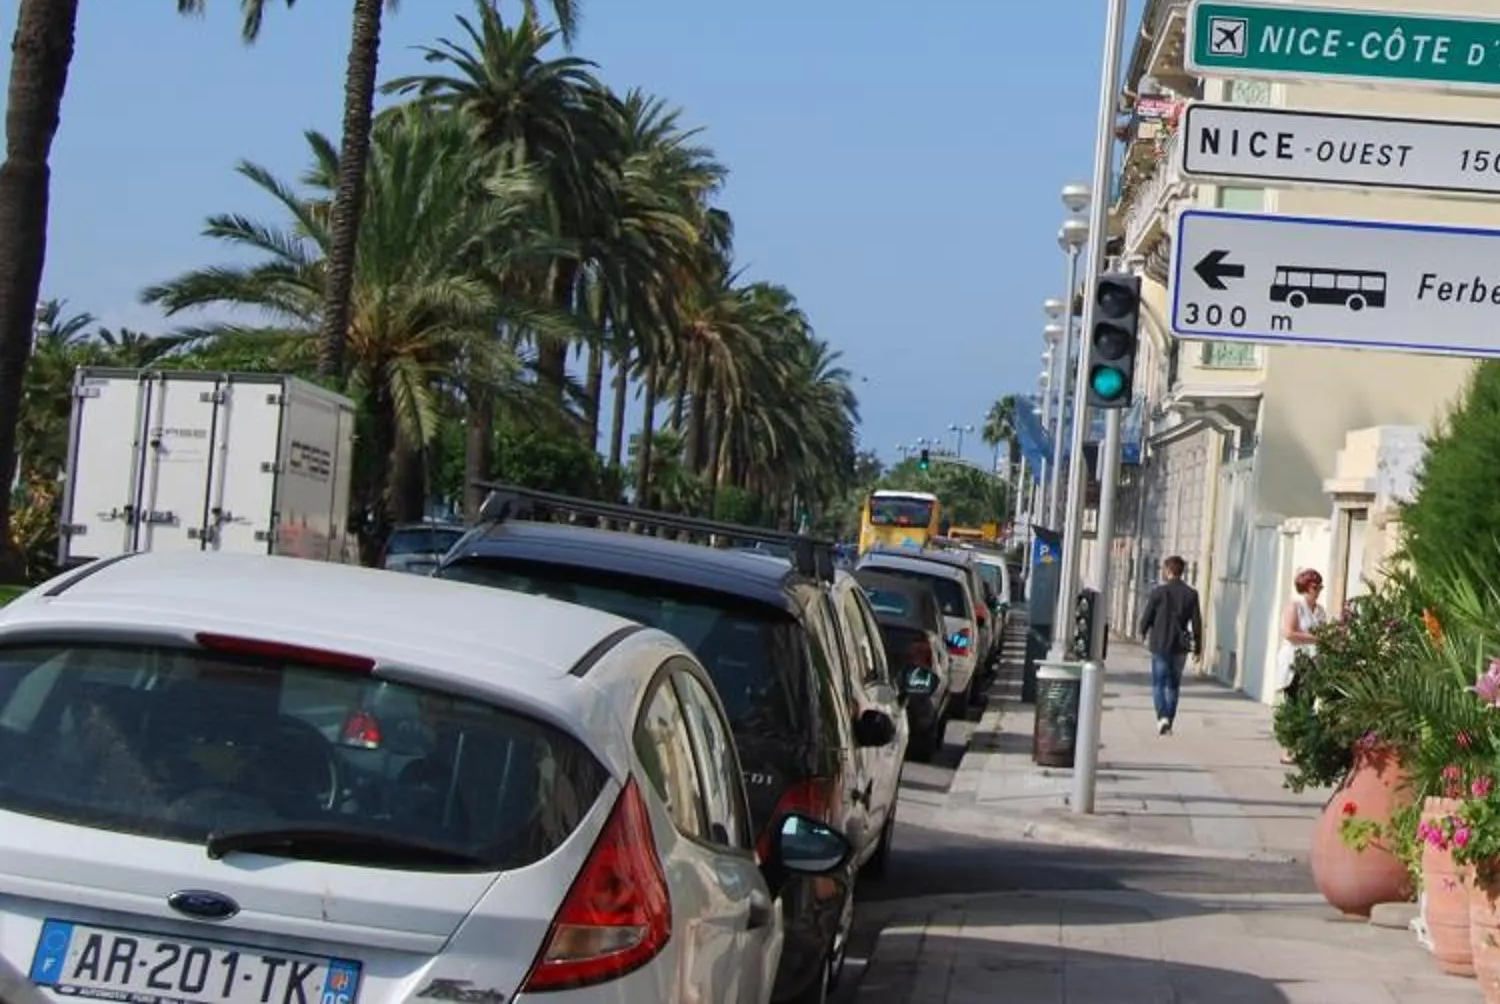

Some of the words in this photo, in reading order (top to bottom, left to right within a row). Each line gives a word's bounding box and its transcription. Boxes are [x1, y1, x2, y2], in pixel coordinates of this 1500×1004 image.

[1259, 27, 1450, 65] NICE-CÔTE
[1200, 127, 1413, 167] NICE-OUEST
[1184, 302, 1247, 328] 300
[1270, 314, 1292, 333] m
